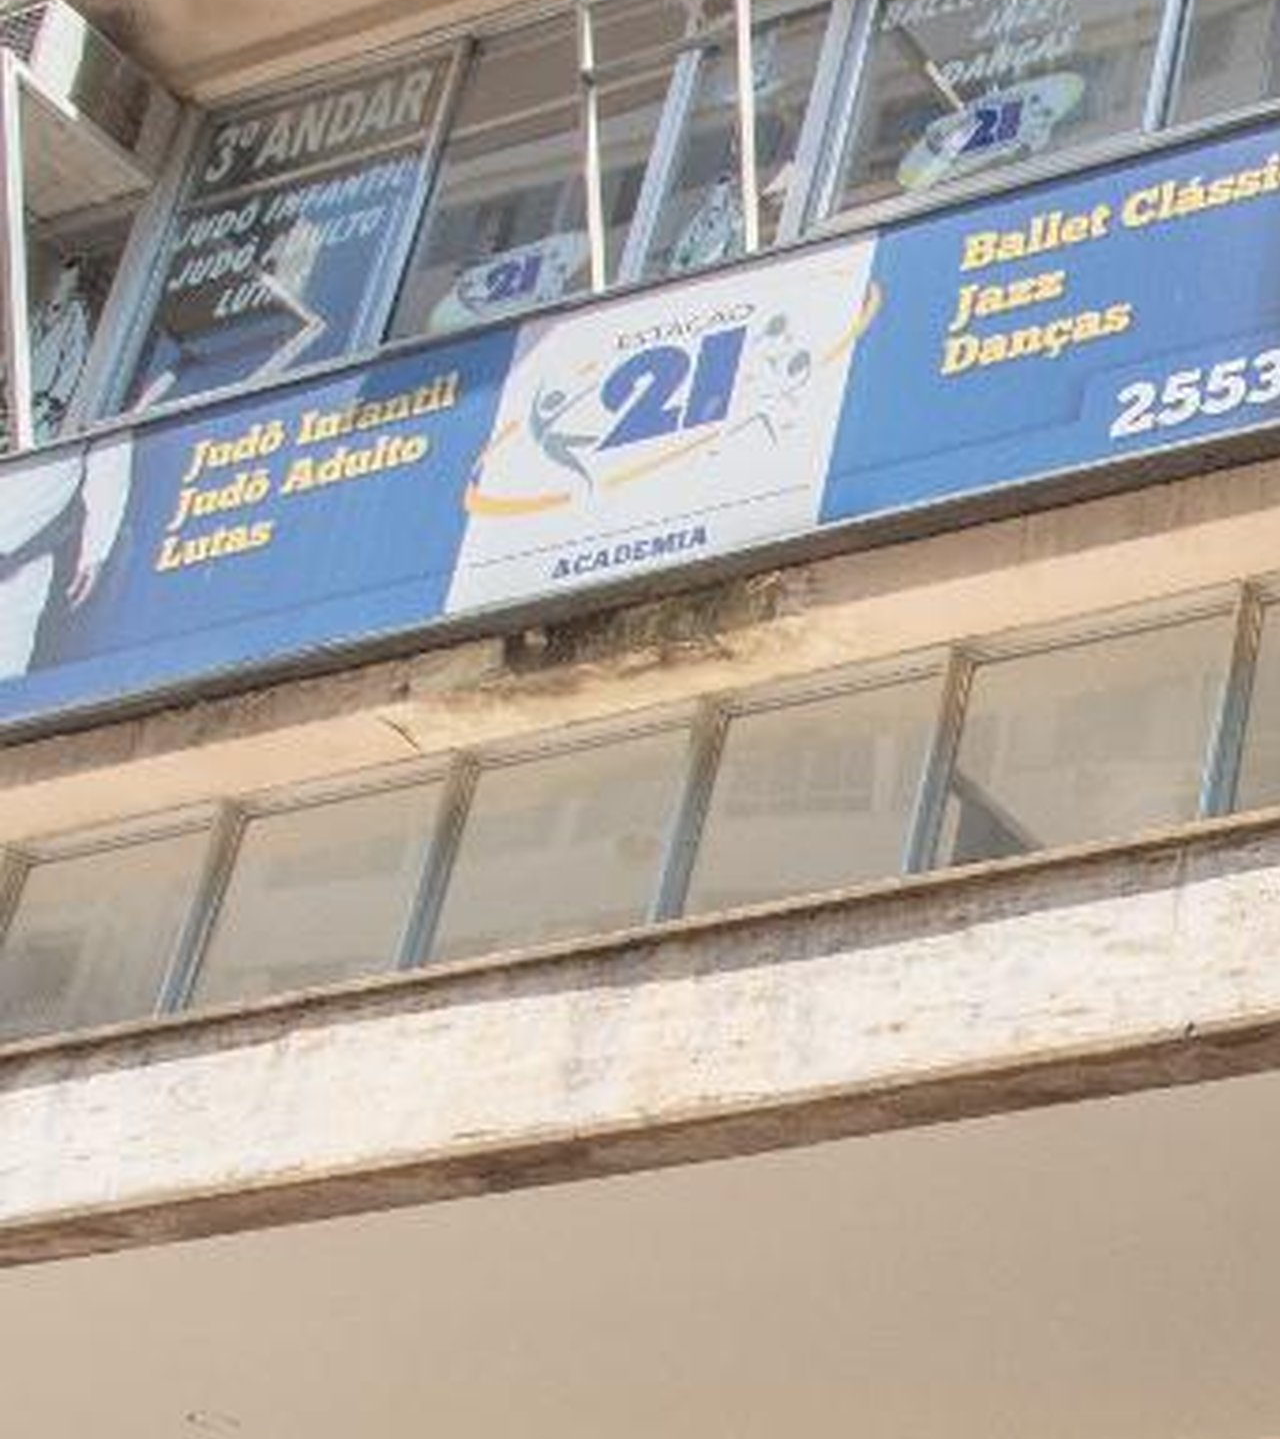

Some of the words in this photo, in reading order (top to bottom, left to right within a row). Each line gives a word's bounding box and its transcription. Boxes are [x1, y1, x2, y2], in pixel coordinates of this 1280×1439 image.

[254, 68, 434, 167] ANDAR
[960, 205, 1110, 271] Ballet
[950, 268, 1066, 330] Jazz
[942, 299, 1134, 375] Danças
[297, 370, 459, 445] Infantil
[596, 325, 748, 452] 21
[280, 434, 429, 494] Adulto
[156, 520, 275, 573] Lutas
[551, 525, 708, 580] ACADEMIA
